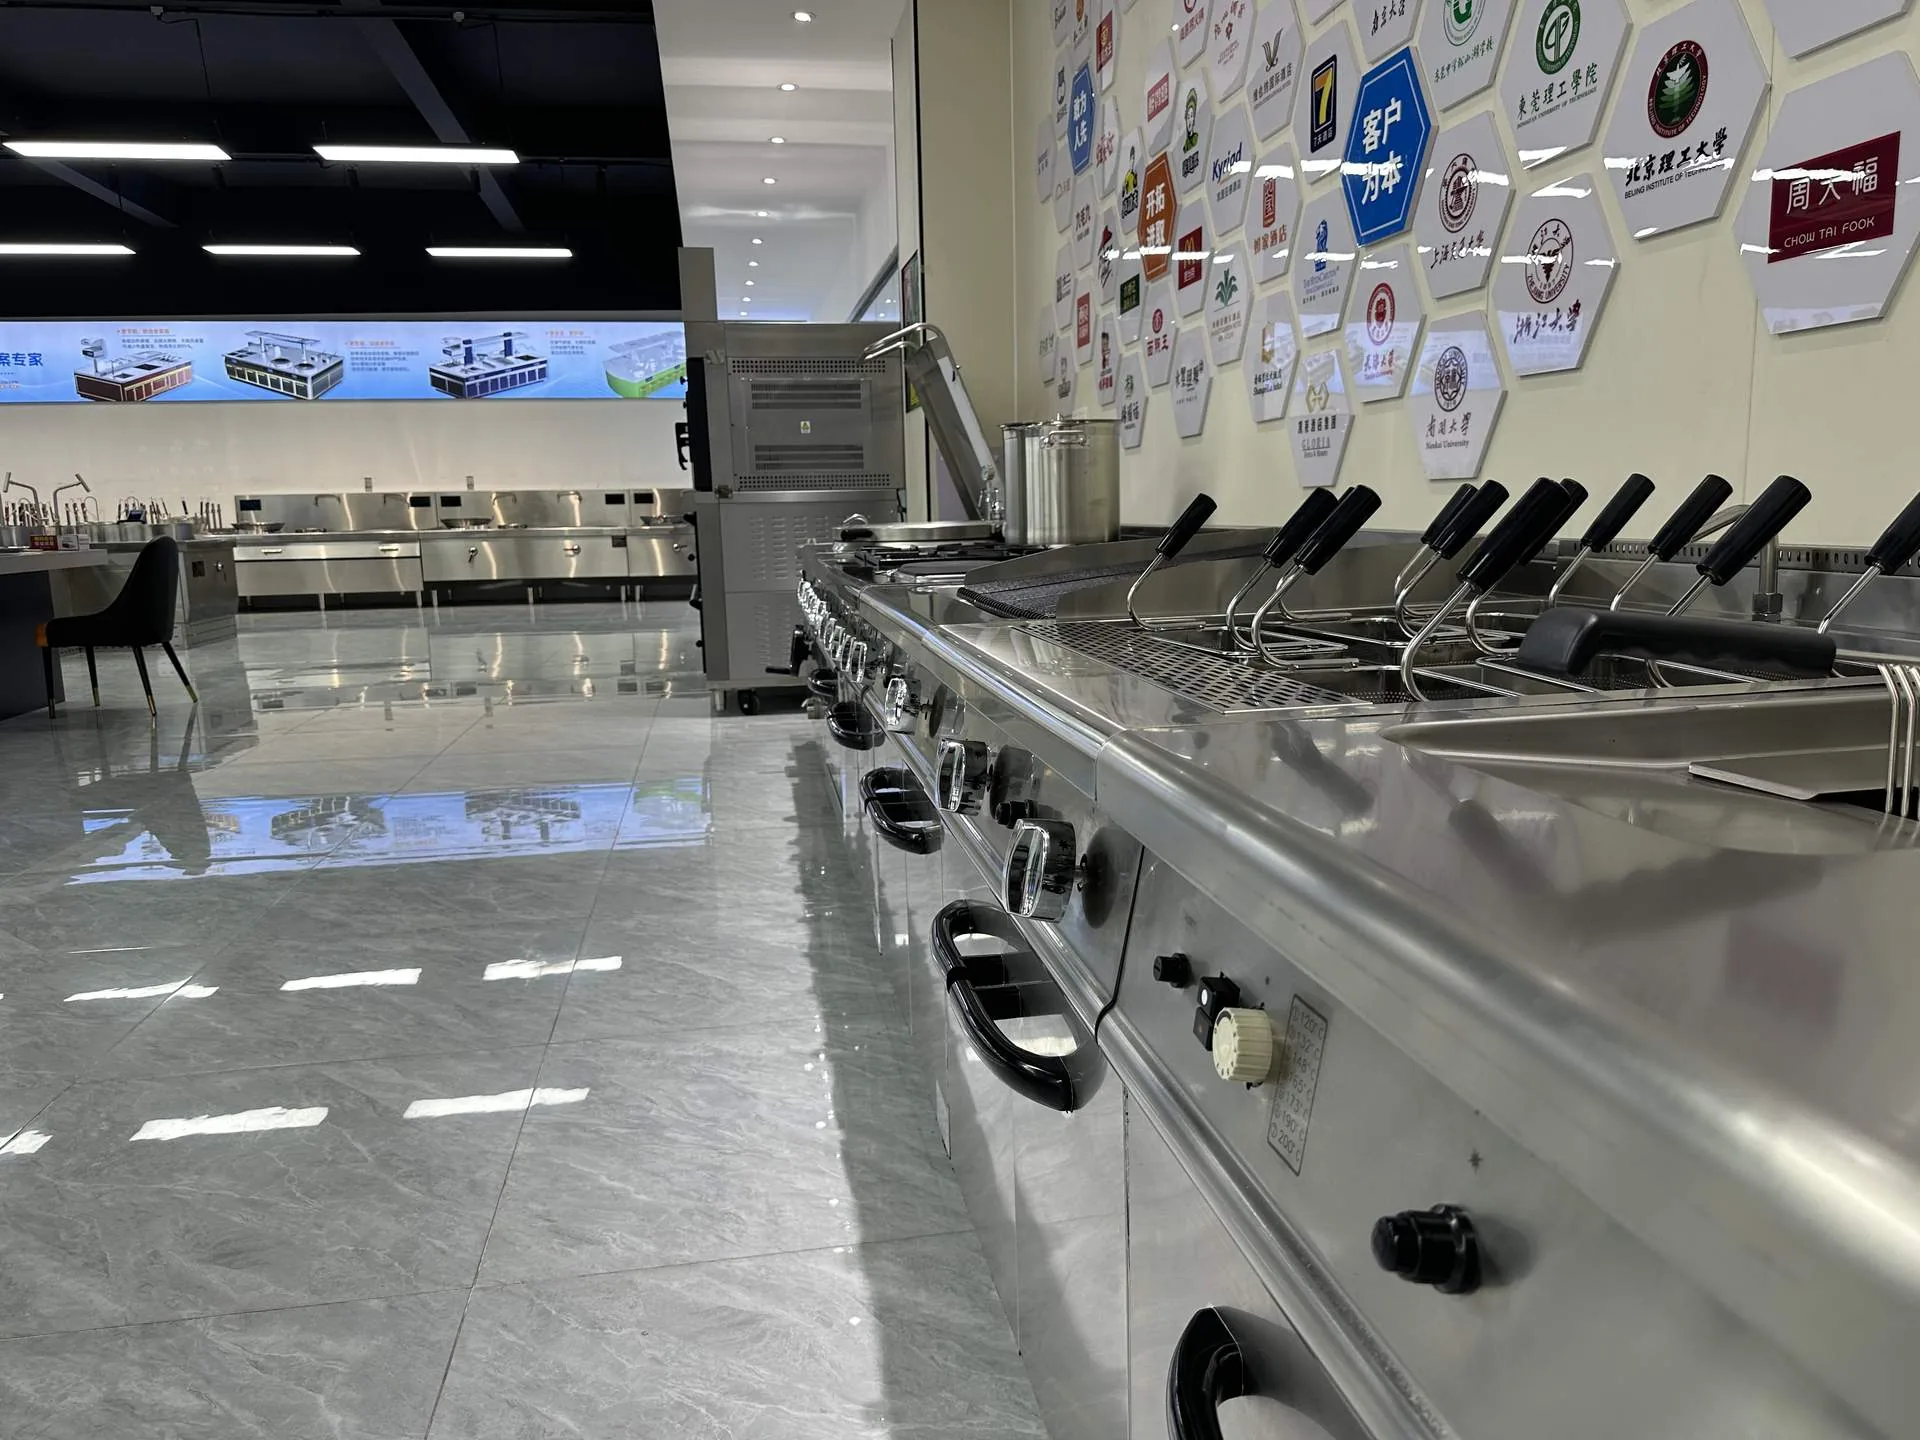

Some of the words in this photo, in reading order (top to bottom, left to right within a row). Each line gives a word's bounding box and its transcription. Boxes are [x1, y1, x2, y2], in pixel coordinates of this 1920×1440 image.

[1314, 67, 1333, 125] 7
[1362, 97, 1401, 154] 客户
[1212, 142, 1242, 182] Kyriad
[1361, 150, 1402, 205] 为本
[1146, 182, 1165, 220] 开拓
[1625, 185, 1645, 199] BEIJING
[1645, 175, 1674, 192] INSTITUTE
[1674, 172, 1683, 182] OF
[1786, 156, 1878, 214] 周大福
[1784, 231, 1815, 248] CHOW
[1819, 226, 1837, 240] TAI
[1842, 216, 1875, 235] FOOK
[1443, 439, 1470, 449] University
